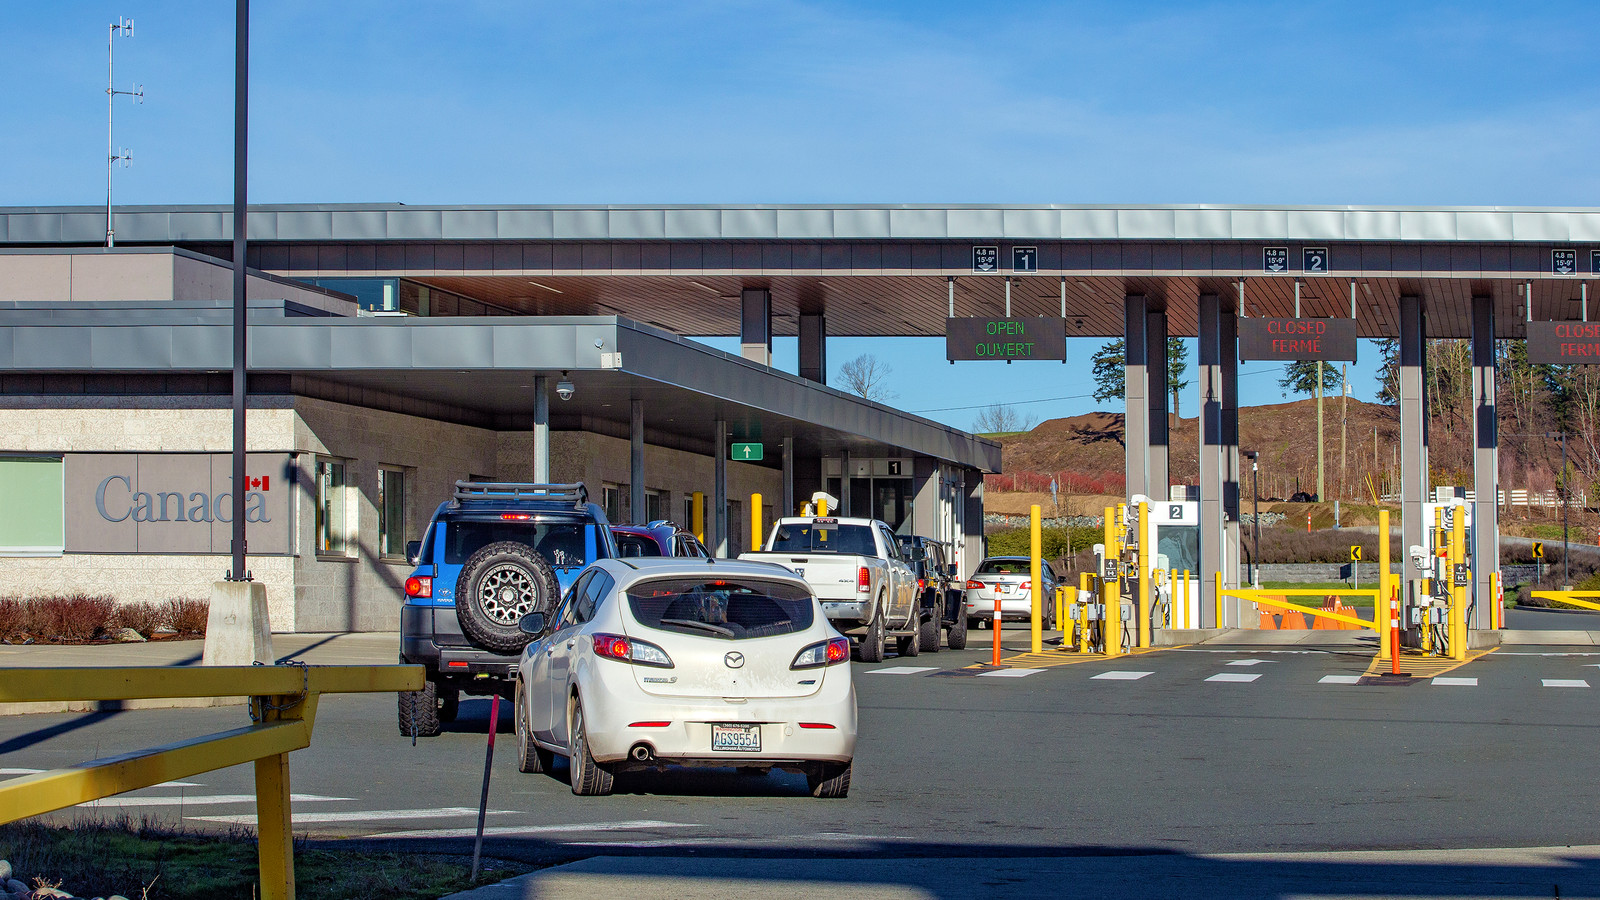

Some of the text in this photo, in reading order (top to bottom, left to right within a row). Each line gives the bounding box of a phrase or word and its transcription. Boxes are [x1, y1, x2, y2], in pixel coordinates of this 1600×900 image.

[1021, 254, 1029, 270] 1
[1311, 255, 1322, 271] 2
[986, 321, 1025, 335] OPEN
[1267, 320, 1326, 335] CLOSED
[1555, 324, 1600, 338] CLOSE
[975, 342, 1035, 356] OUVERT
[1272, 335, 1322, 353] FERMÉ
[1560, 343, 1600, 356] FERM
[891, 462, 898, 474] 1
[95, 474, 272, 523] Canada
[1172, 506, 1181, 518] 2
[714, 732, 758, 746] AGS9554
